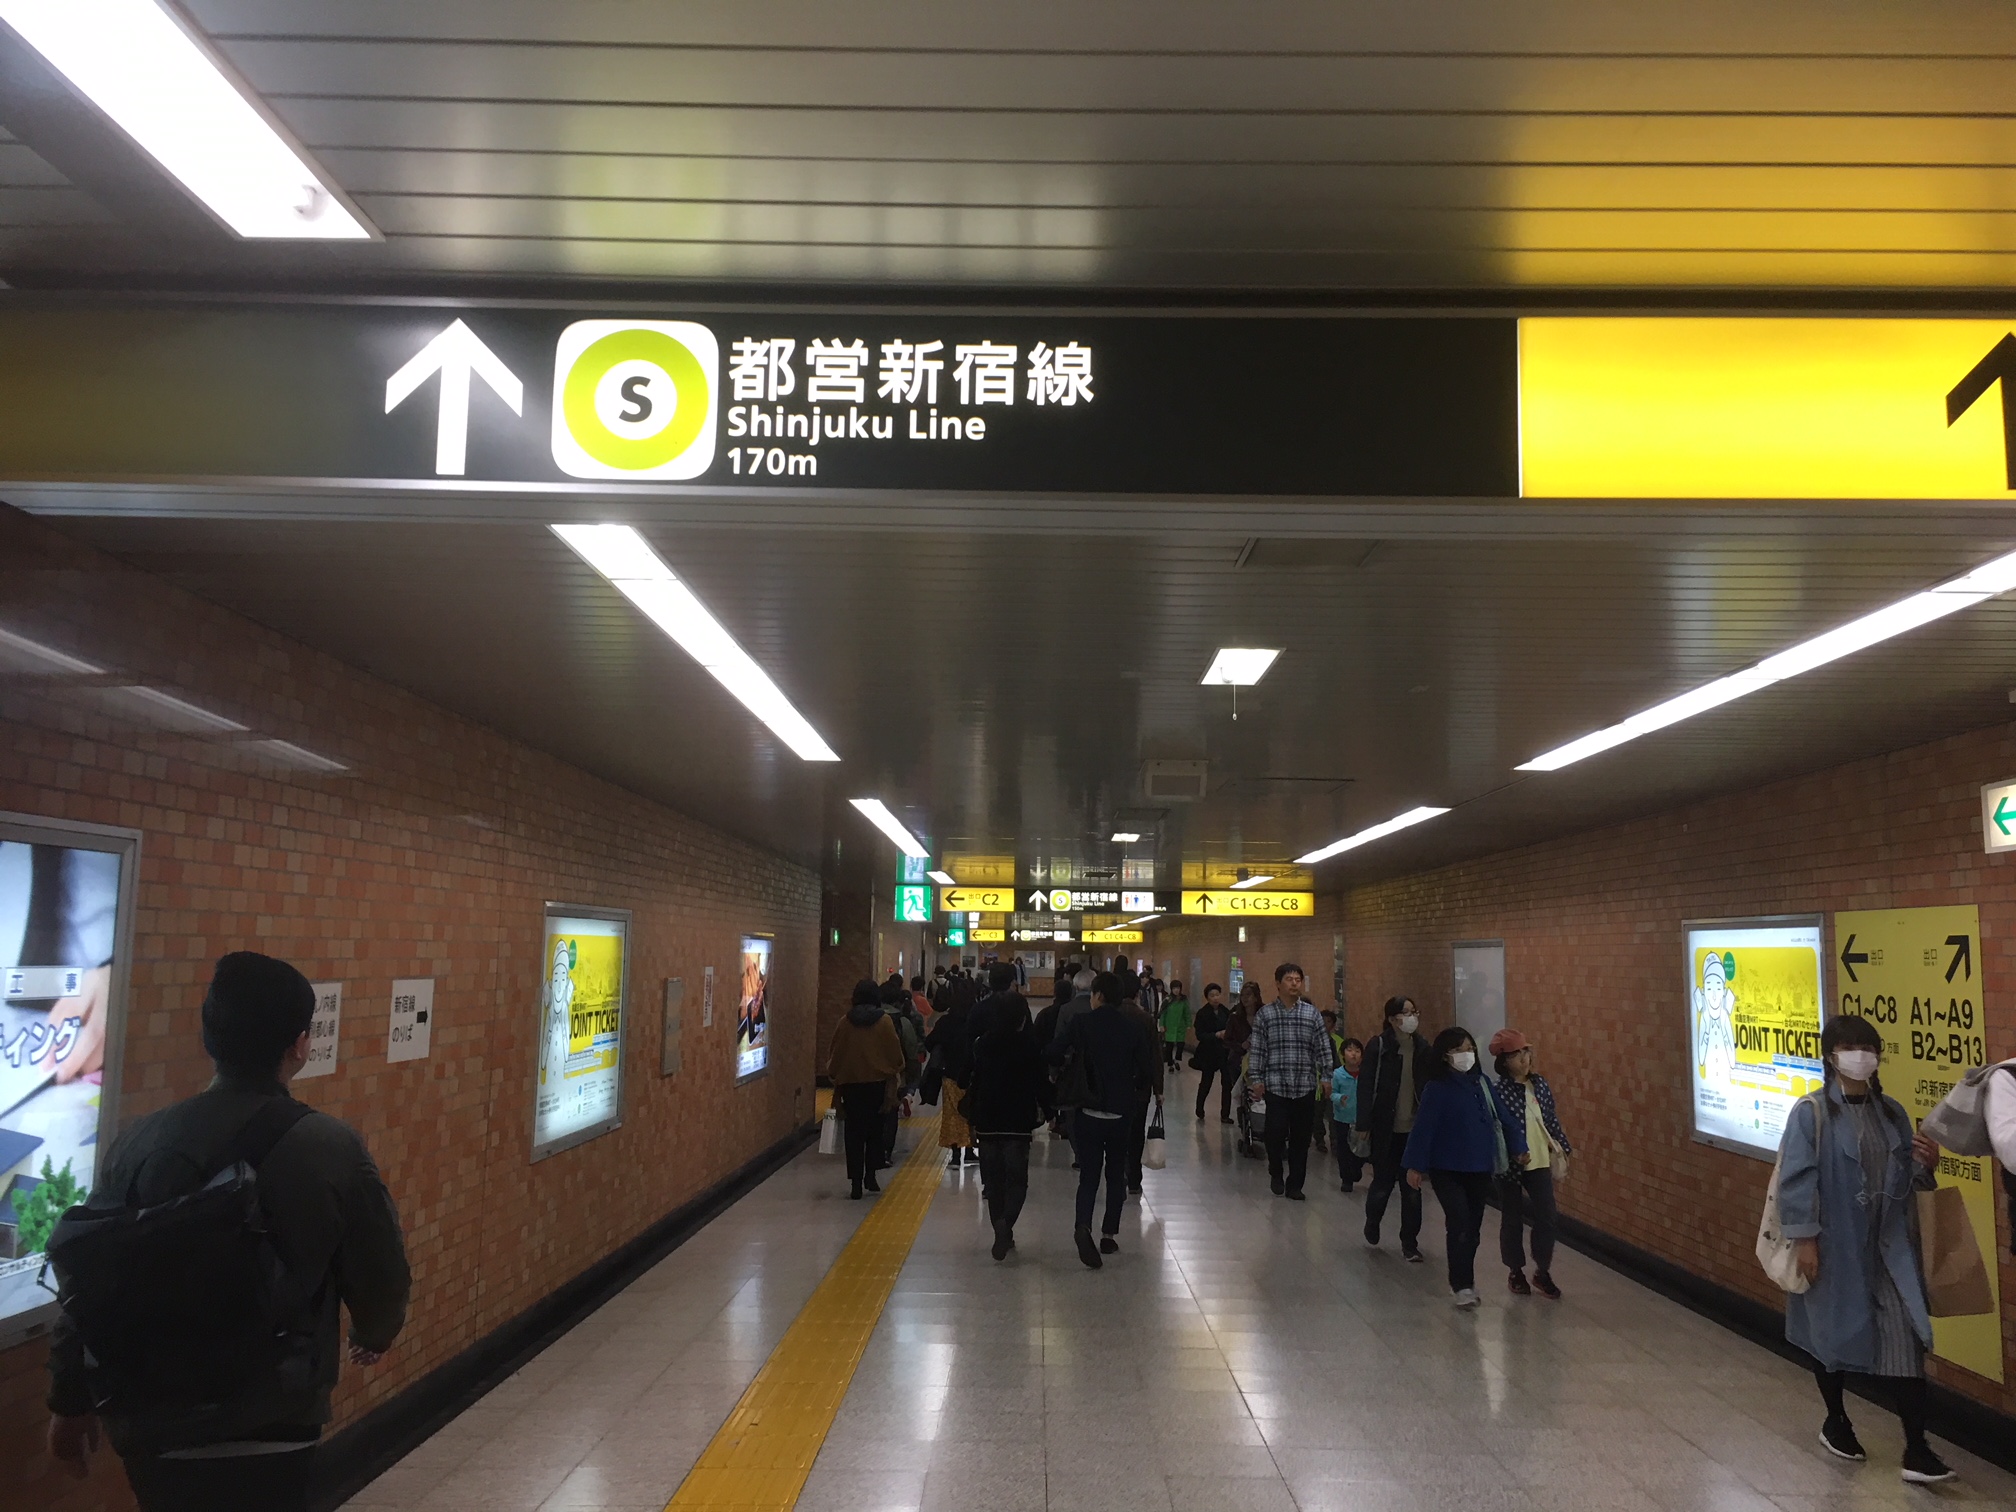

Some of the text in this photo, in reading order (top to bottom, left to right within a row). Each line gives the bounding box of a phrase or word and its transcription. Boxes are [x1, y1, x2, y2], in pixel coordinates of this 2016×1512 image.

[728, 336, 1095, 406] 都営新宿線
[619, 375, 653, 423] S
[727, 404, 987, 446] Shinjuku Line
[727, 447, 818, 476] 170m
[982, 893, 1000, 906] C2
[0, 1016, 81, 1068] ィング
[570, 1008, 619, 1041] JOINT TICKET
[1734, 1024, 1821, 1059] JOINT TICKET
[1935, 1156, 1982, 1182] 宿駅方面
